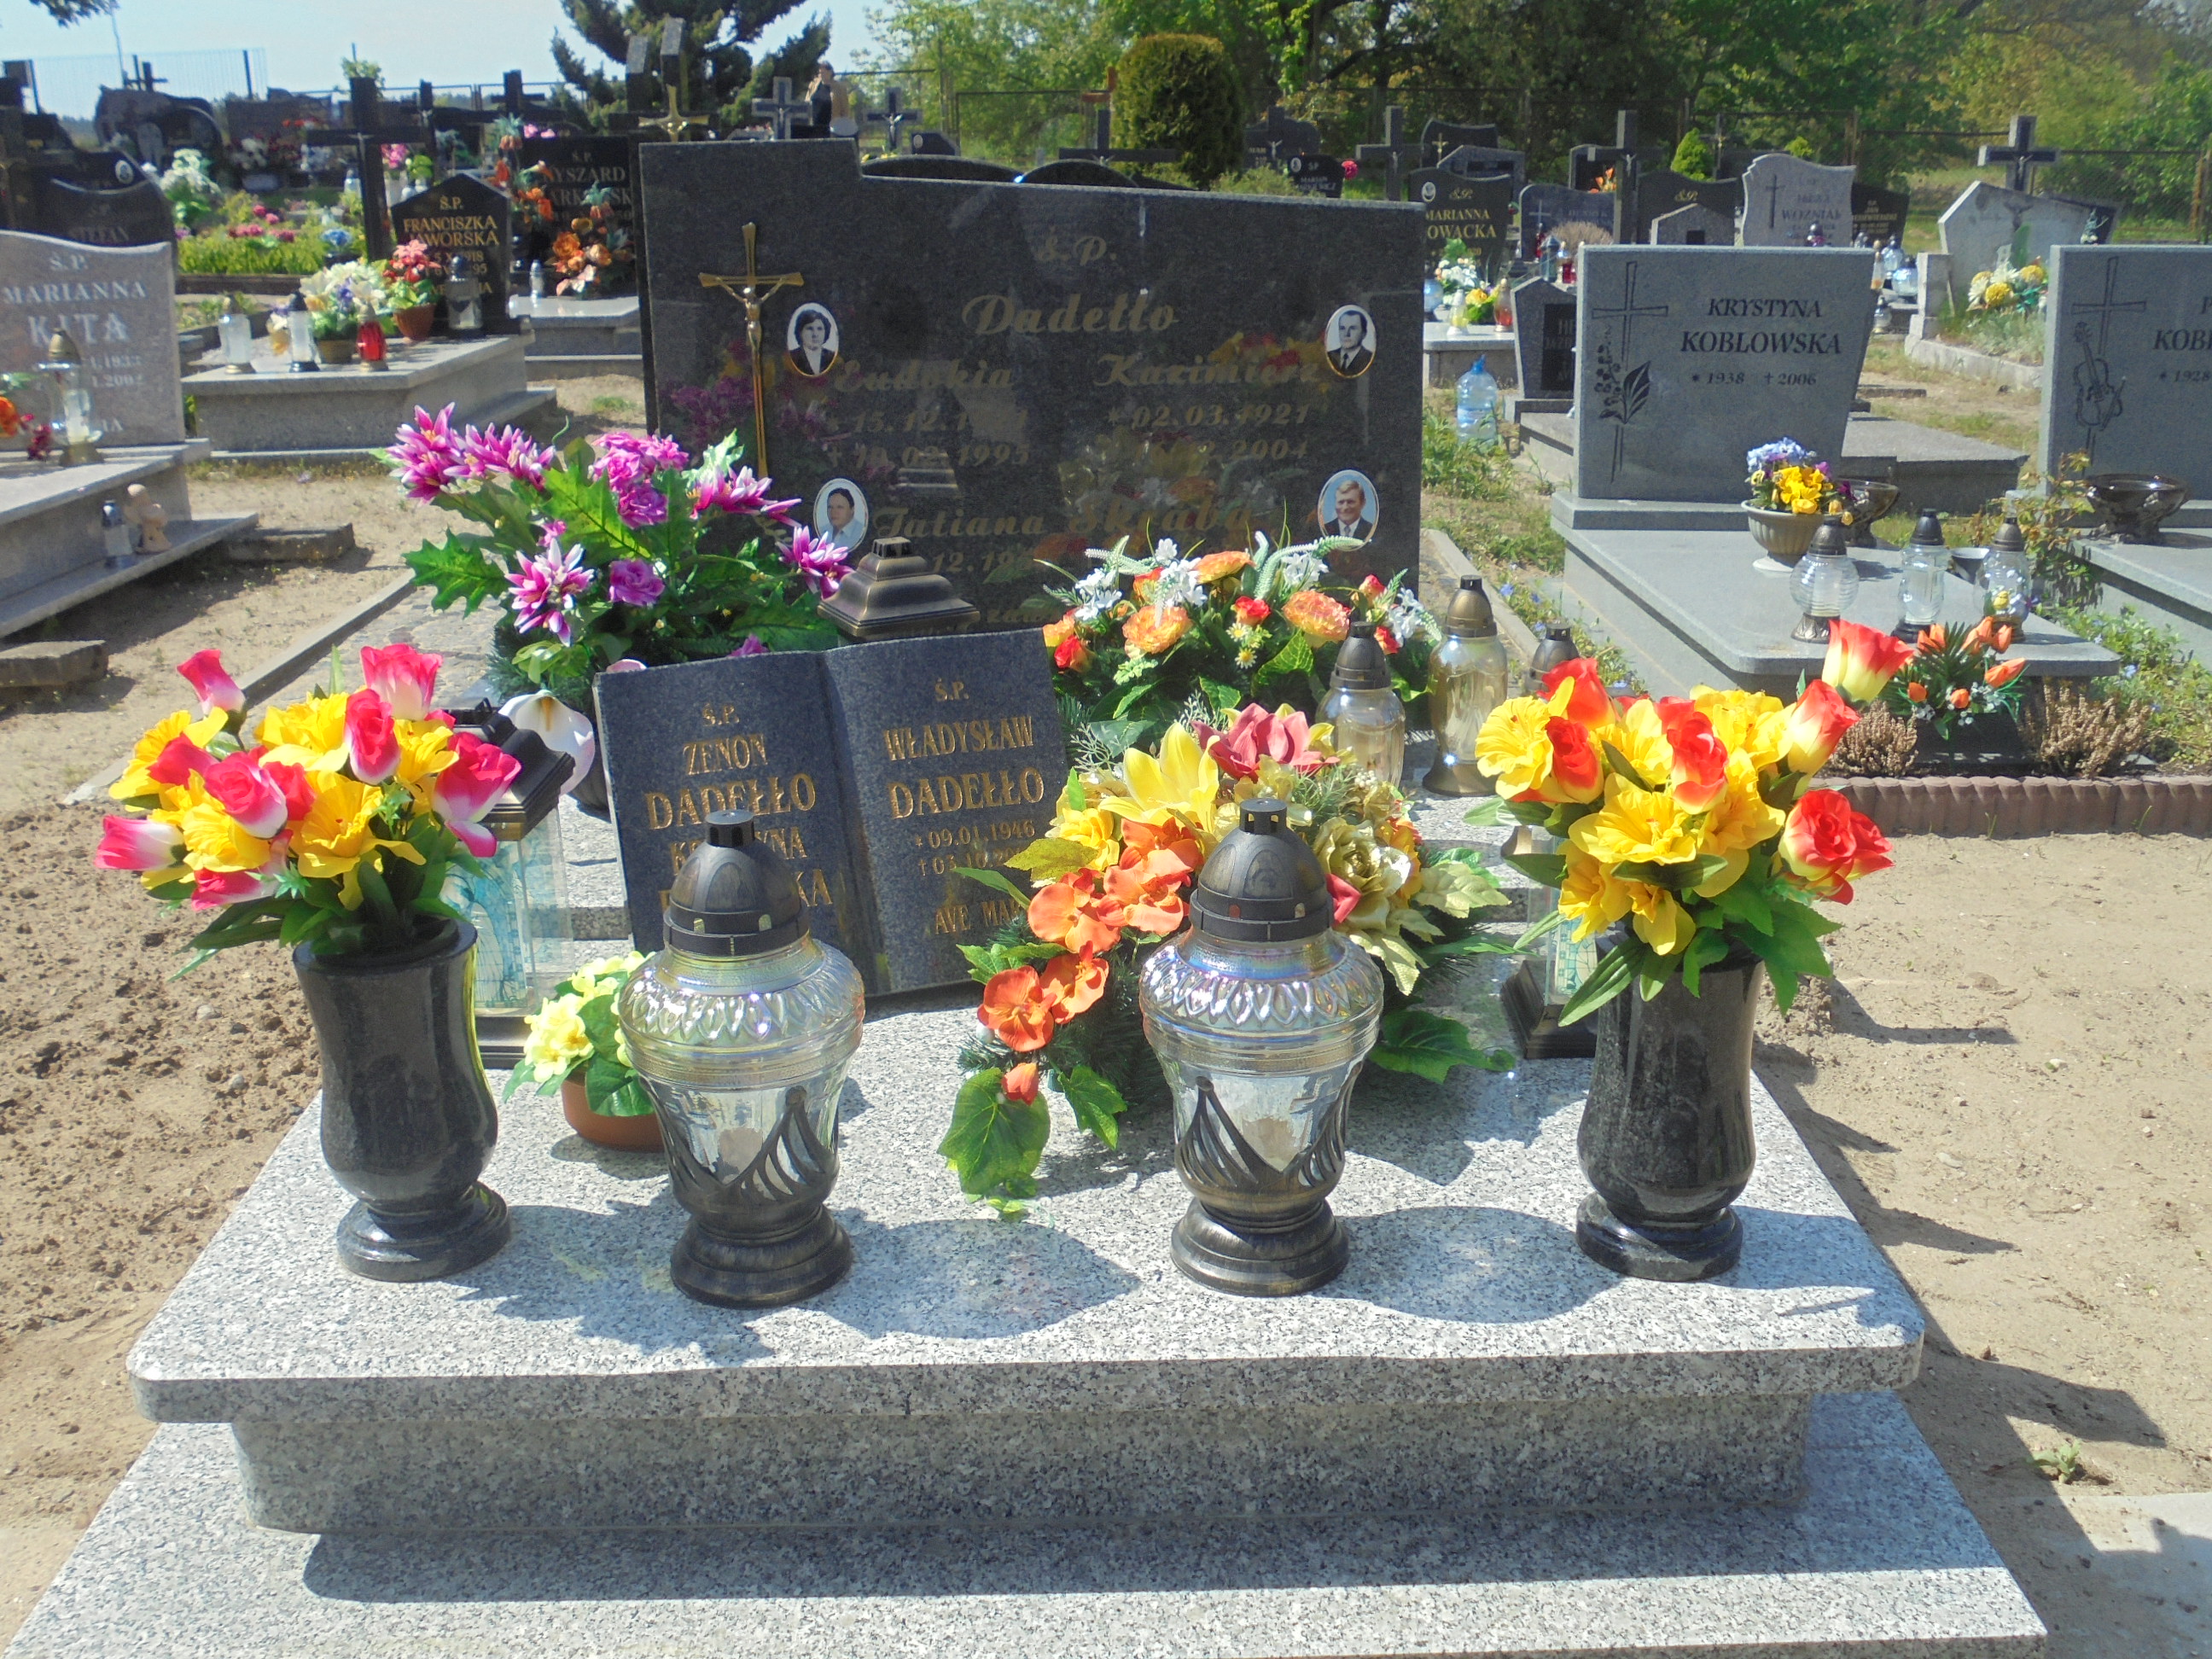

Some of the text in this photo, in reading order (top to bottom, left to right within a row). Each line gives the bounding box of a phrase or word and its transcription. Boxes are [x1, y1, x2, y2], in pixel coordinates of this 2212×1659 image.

[544, 166, 626, 183] YSZARD
[404, 214, 498, 233] FRANCISZKA
[1427, 224, 1497, 239] OWACKA
[410, 230, 500, 247] AWORSKA
[3, 280, 147, 304] MARIANNA
[1708, 298, 1822, 317] KRYSTYNA
[27, 312, 129, 346] KITA
[2152, 328, 2212, 351] KOB
[834, 358, 1016, 393] Eudokia
[1093, 352, 1322, 387] Kazimierz
[1708, 372, 1817, 386] 1938 2006
[853, 410, 1029, 433] 15.12.11
[873, 506, 1049, 538] Tatiana
[934, 677, 969, 702] Ś.P.
[882, 715, 1034, 761] WŁADYSŁAW
[683, 733, 768, 776] ZENON
[644, 771, 817, 830] DADEŁŁO
[887, 766, 1045, 819] DADEŁŁO
[928, 819, 1035, 849] 09.01.1946
[935, 897, 1026, 934] AVE MAR
